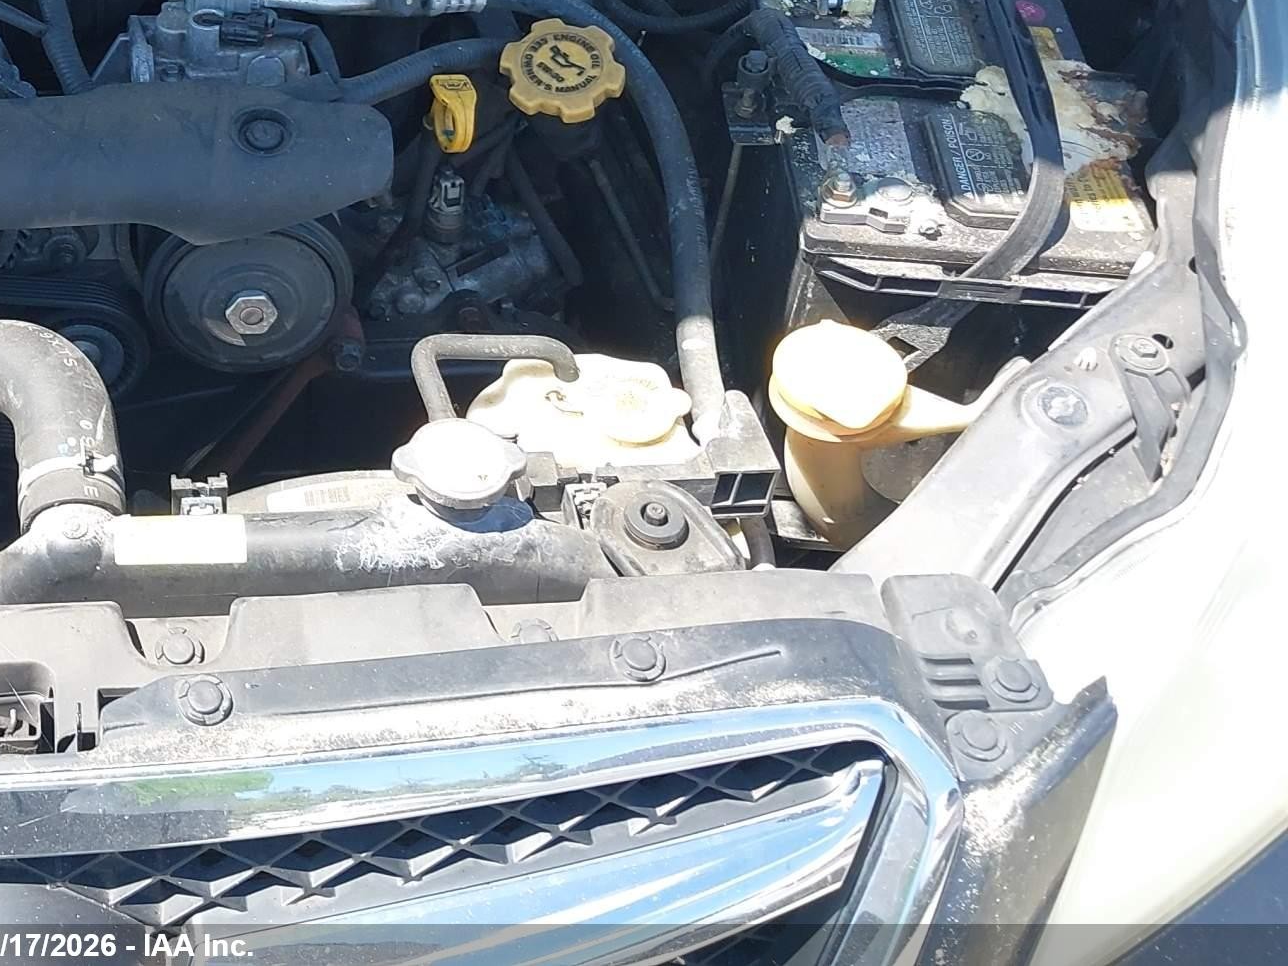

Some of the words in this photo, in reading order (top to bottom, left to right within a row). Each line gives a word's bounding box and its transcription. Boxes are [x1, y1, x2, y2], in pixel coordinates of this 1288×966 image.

[553, 34, 594, 53] ENGINE
[590, 54, 601, 69] OIL
[523, 54, 552, 91] OWNER'S
[555, 75, 598, 93] MANUAL
[941, 118, 958, 149] POISON
[952, 156, 972, 191] DANGER
